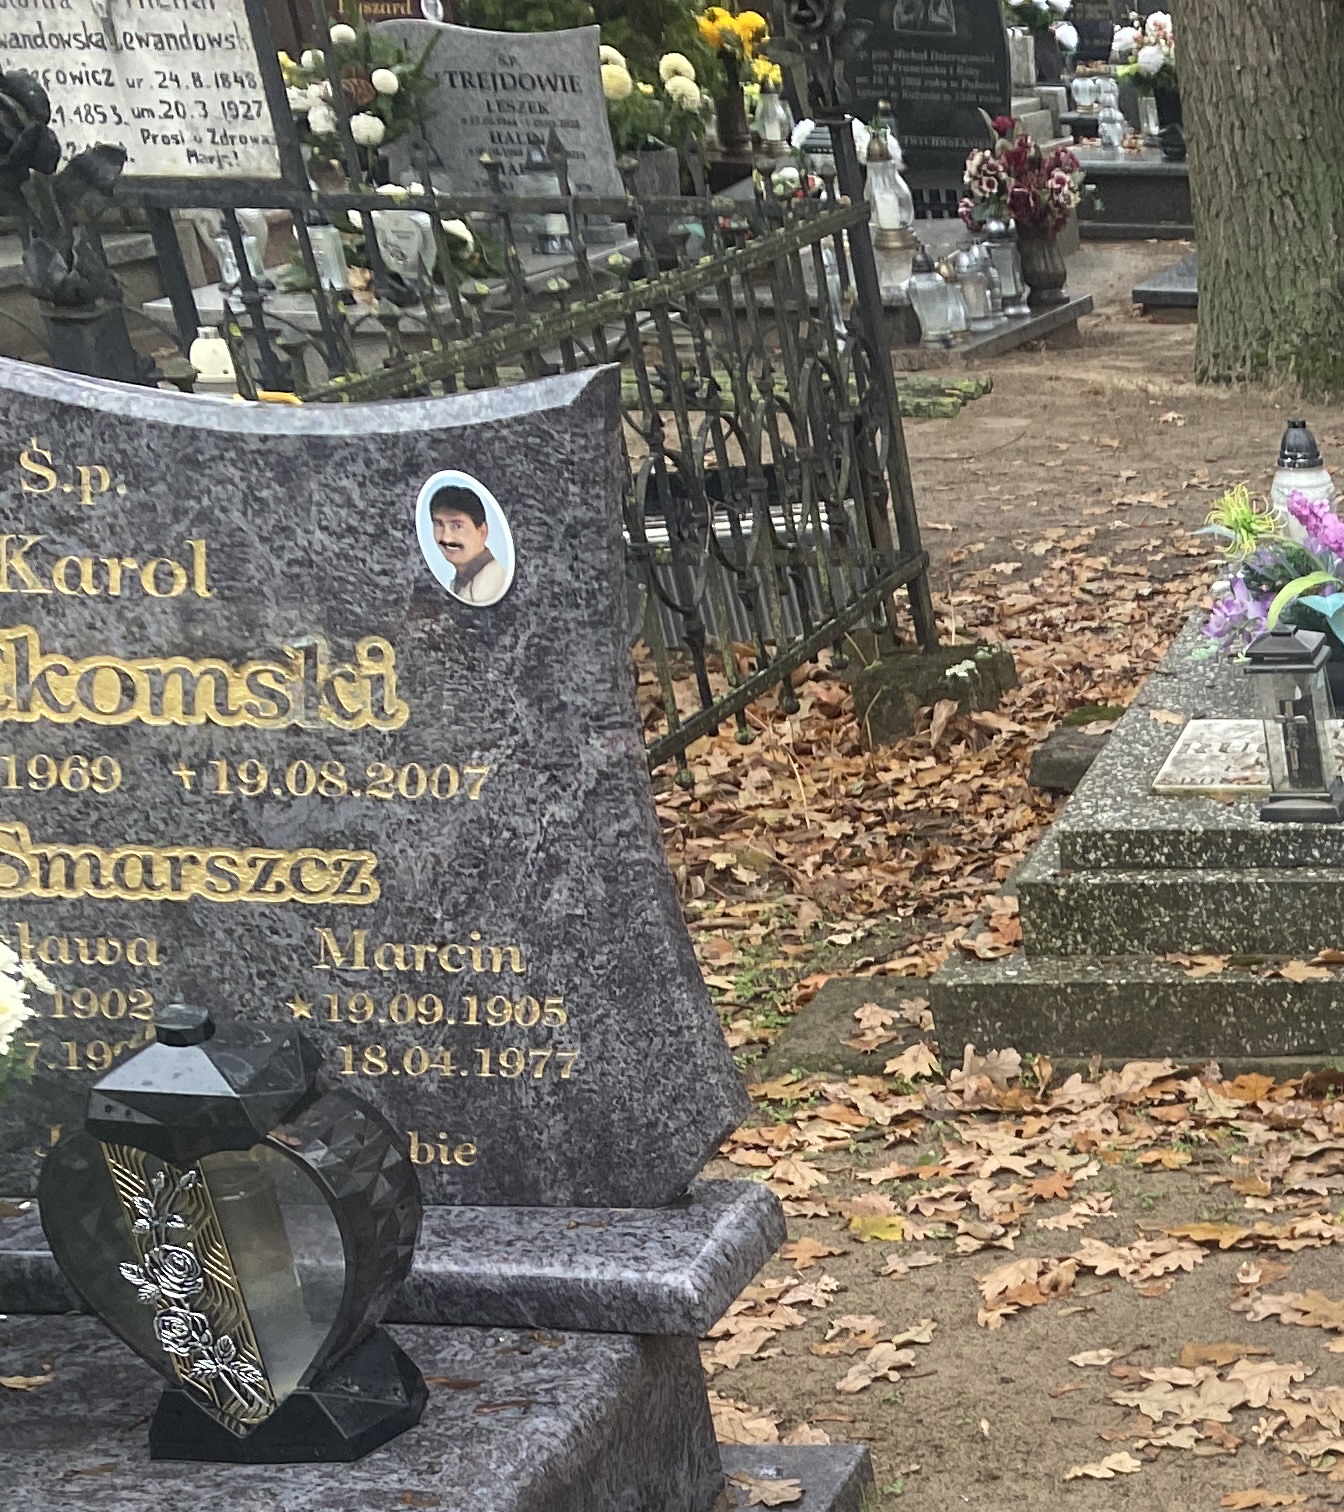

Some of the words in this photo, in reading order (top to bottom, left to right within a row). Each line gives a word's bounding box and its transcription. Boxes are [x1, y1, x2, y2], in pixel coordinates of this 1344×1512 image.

[206, 127, 277, 147] Zdrowa
[19, 436, 128, 505] Ś.p.
[0, 534, 217, 599] Karol
[0, 628, 408, 728] komski
[211, 759, 495, 801] 19.08.2007
[0, 820, 382, 905] Smarszcz
[14, 919, 163, 967] ława
[313, 927, 528, 974] Marcin
[324, 992, 569, 1028] 19.09.1905
[338, 1043, 581, 1080] 18.04.1977
